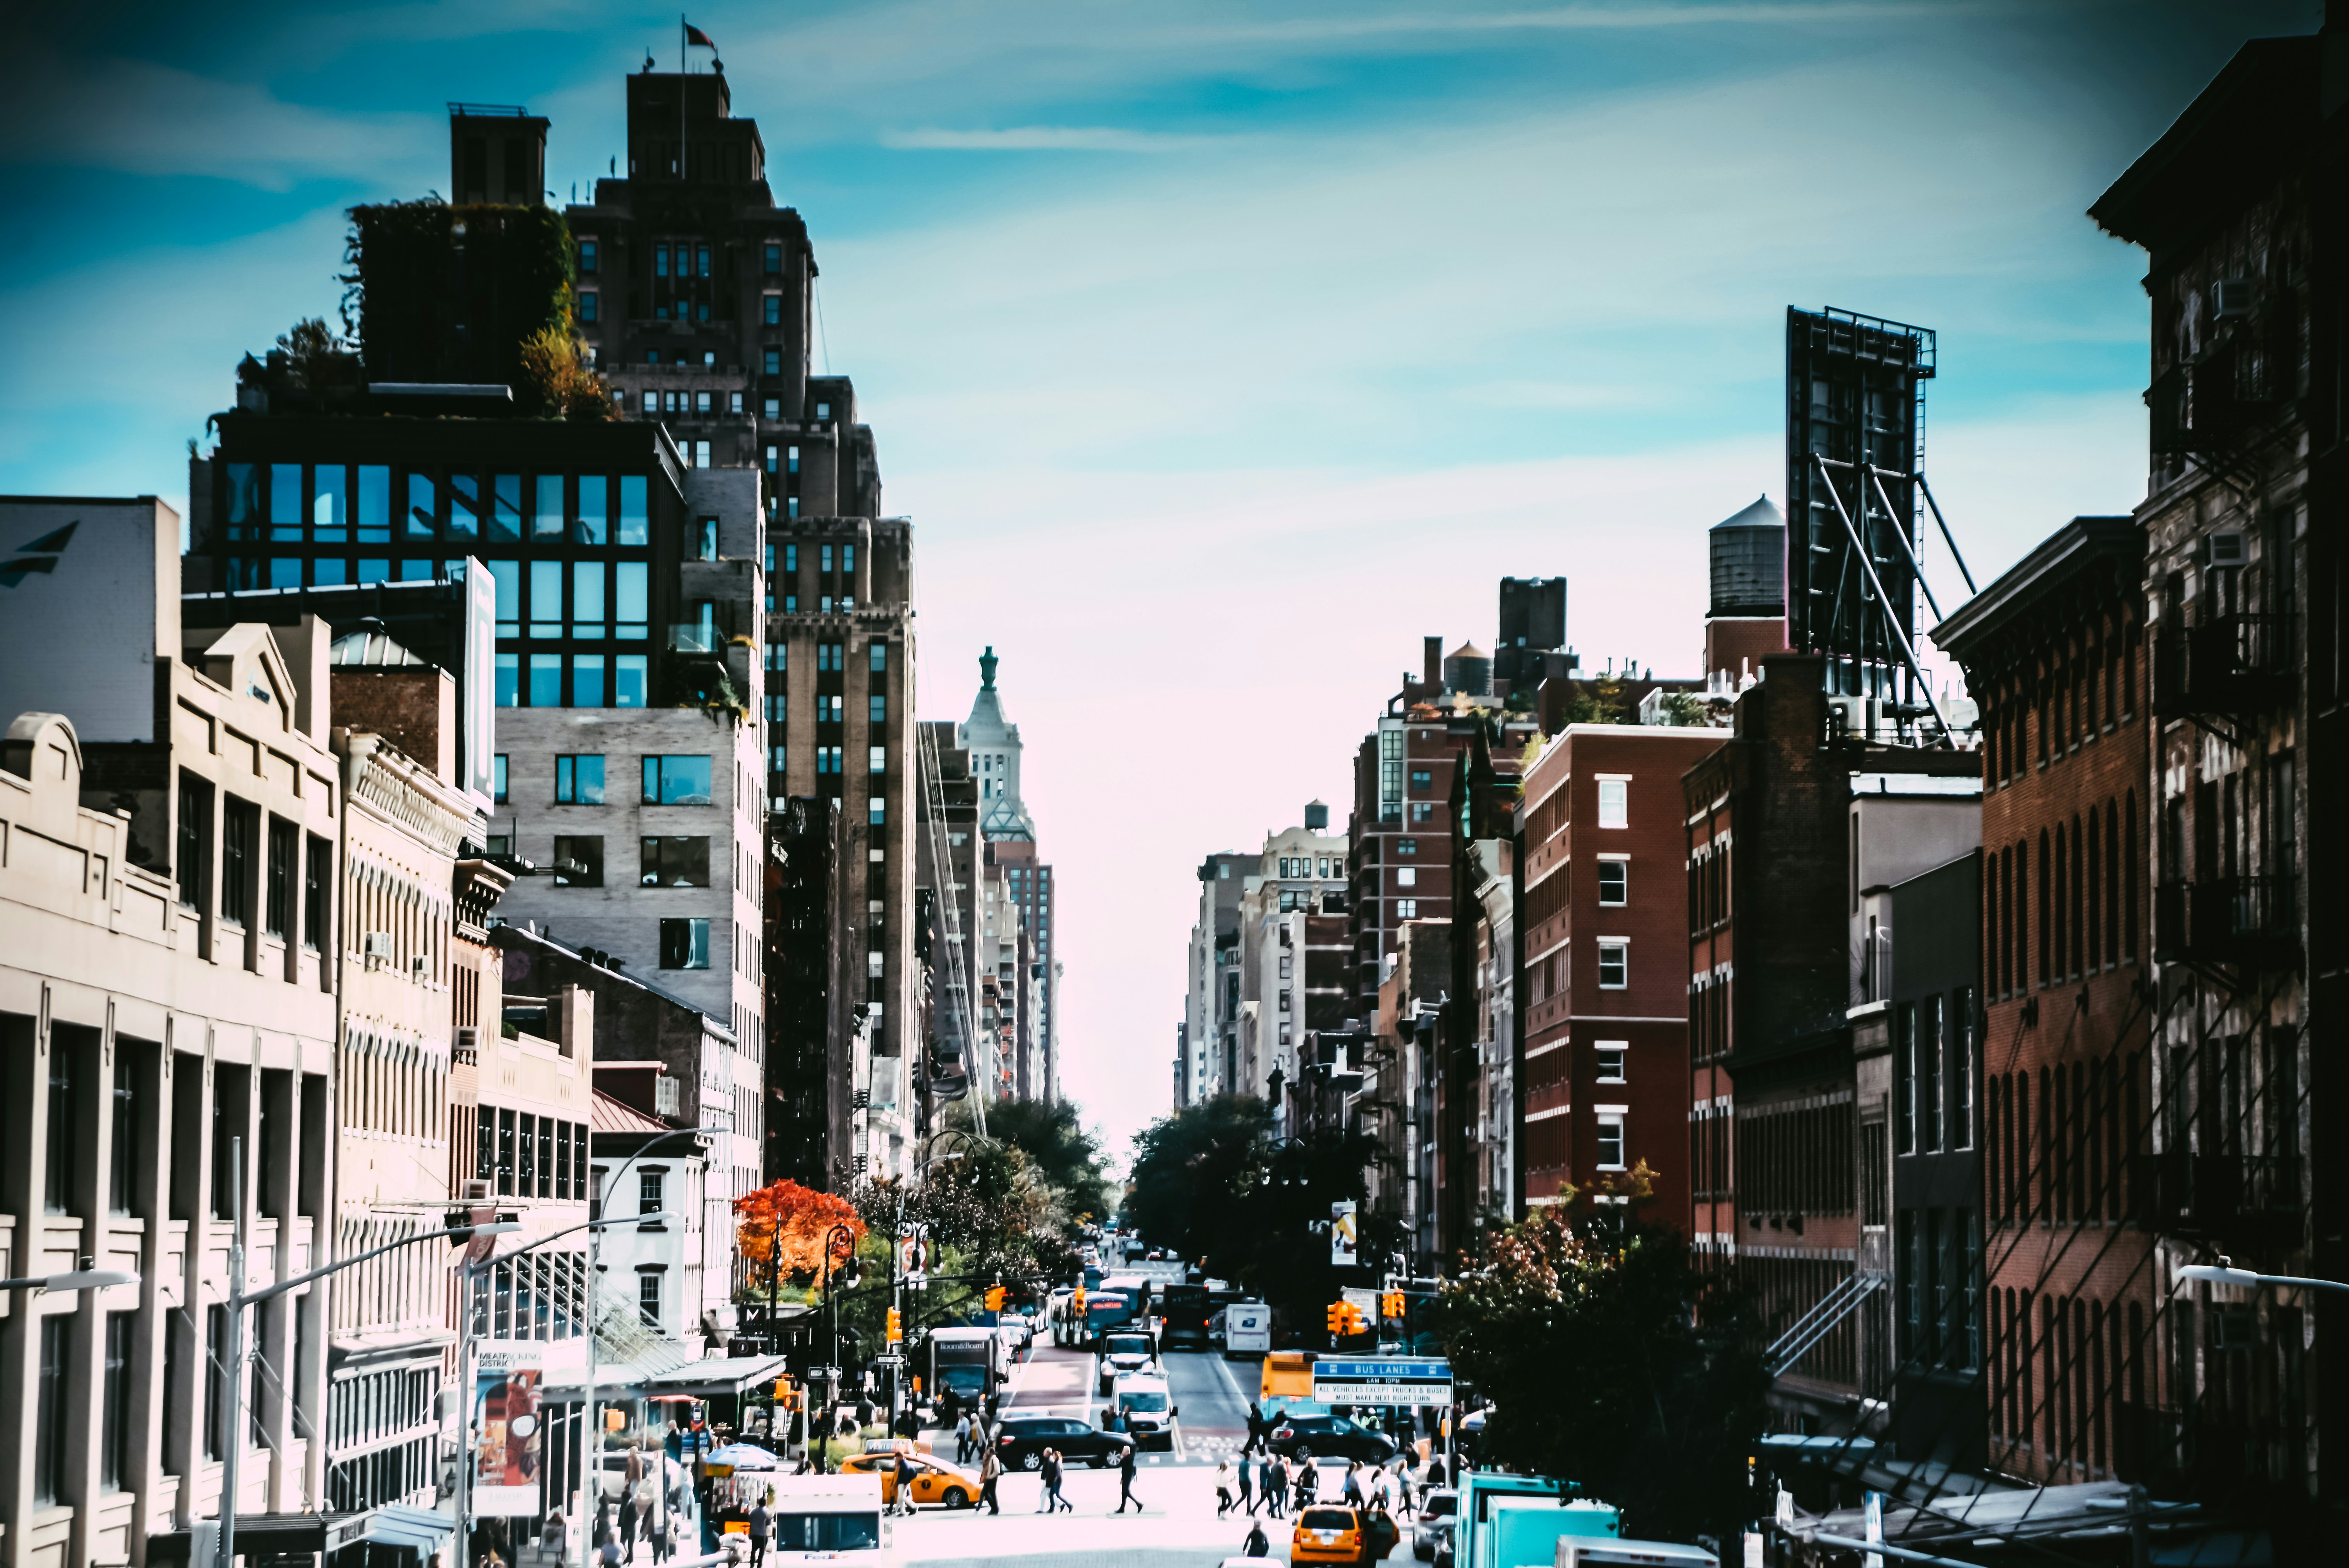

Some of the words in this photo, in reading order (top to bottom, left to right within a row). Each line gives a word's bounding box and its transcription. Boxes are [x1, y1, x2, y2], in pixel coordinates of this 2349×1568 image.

[940, 1341, 984, 1349] Room&Board
[1356, 1365, 1374, 1374] BUS
[1380, 1365, 1410, 1374] LANES
